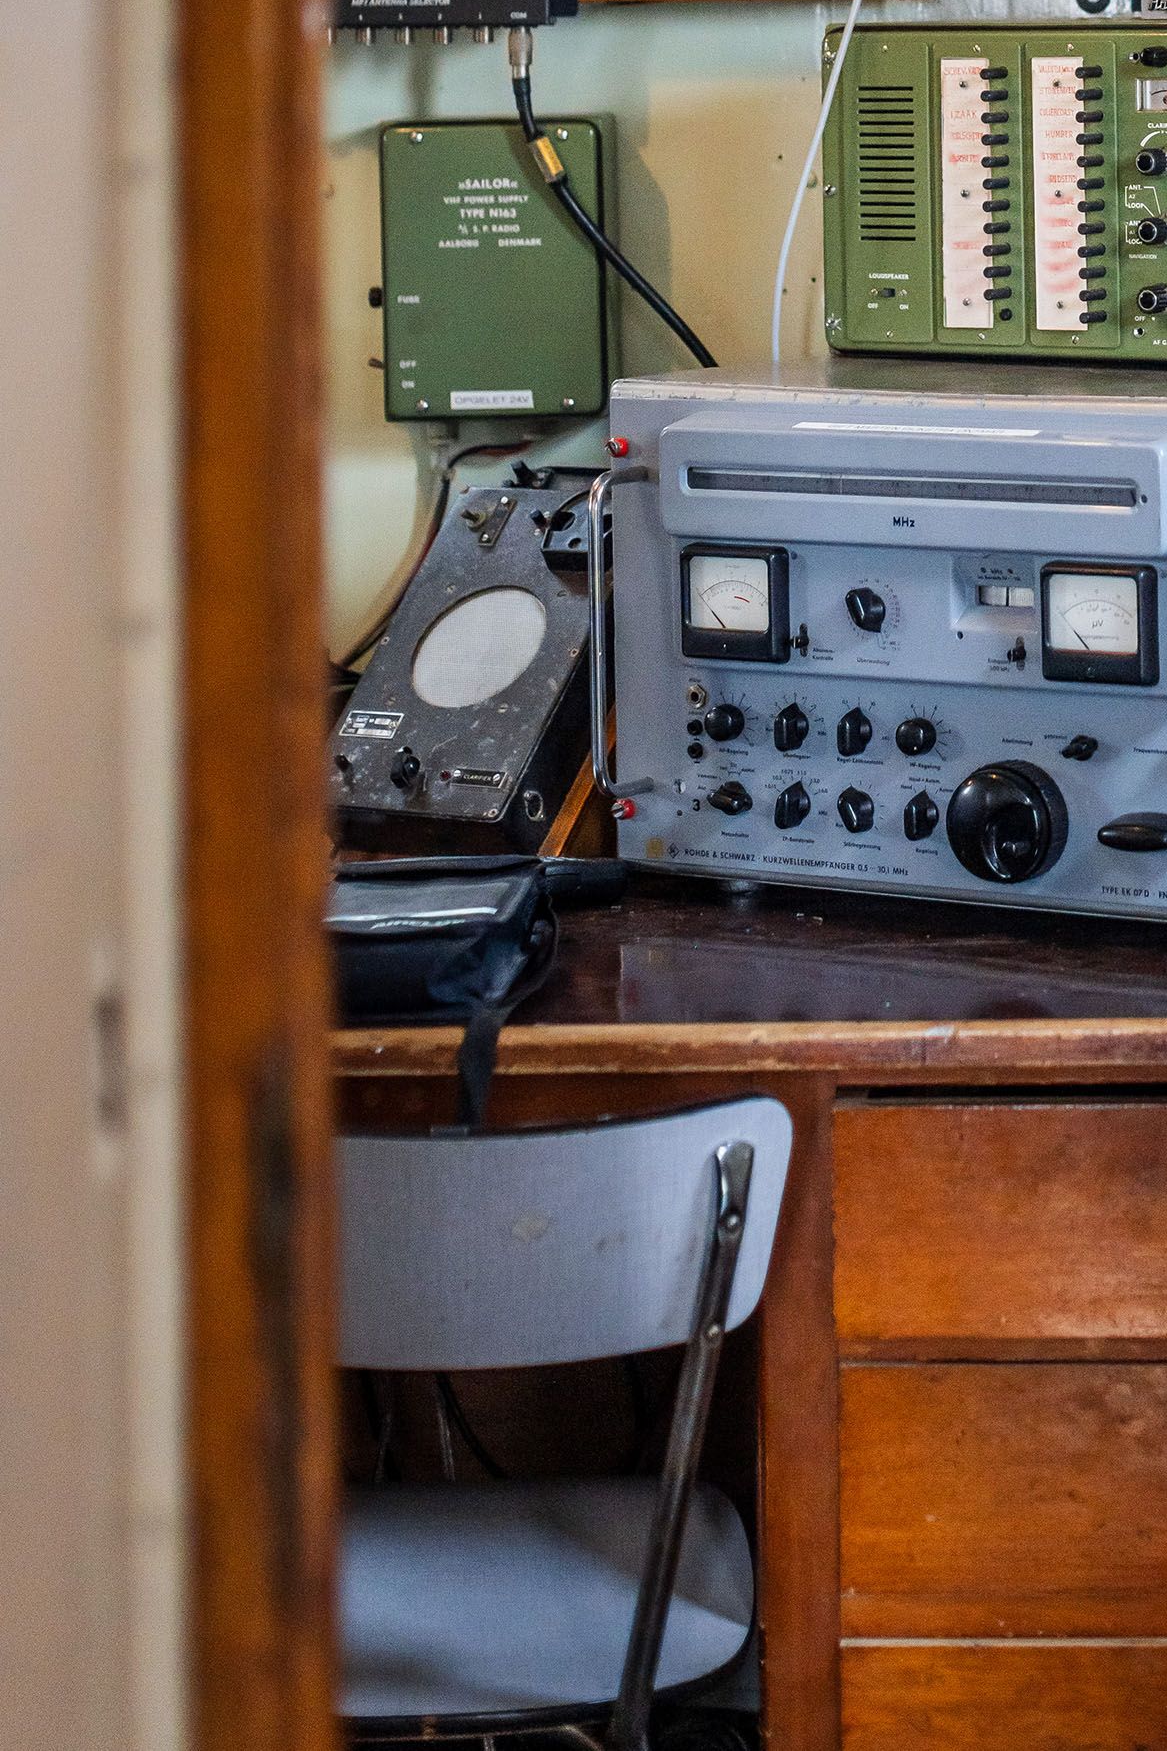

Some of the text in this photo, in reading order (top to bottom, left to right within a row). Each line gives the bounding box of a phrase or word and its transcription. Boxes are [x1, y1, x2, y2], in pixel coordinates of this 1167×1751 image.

[463, 195, 495, 204] POWER
[498, 195, 529, 203] SUPPLY
[460, 208, 485, 219] TYPE
[491, 224, 520, 233] RADIO
[498, 238, 542, 248] DENMARK
[893, 516, 915, 528] MHz
[692, 798, 700, 812] 3
[684, 848, 710, 859] ROHDE
[712, 851, 718, 859] &
[720, 851, 756, 862] SCHWARZ
[892, 866, 909, 876] MHz
[1101, 885, 1118, 895] TYPE
[1121, 887, 1132, 896] EK
